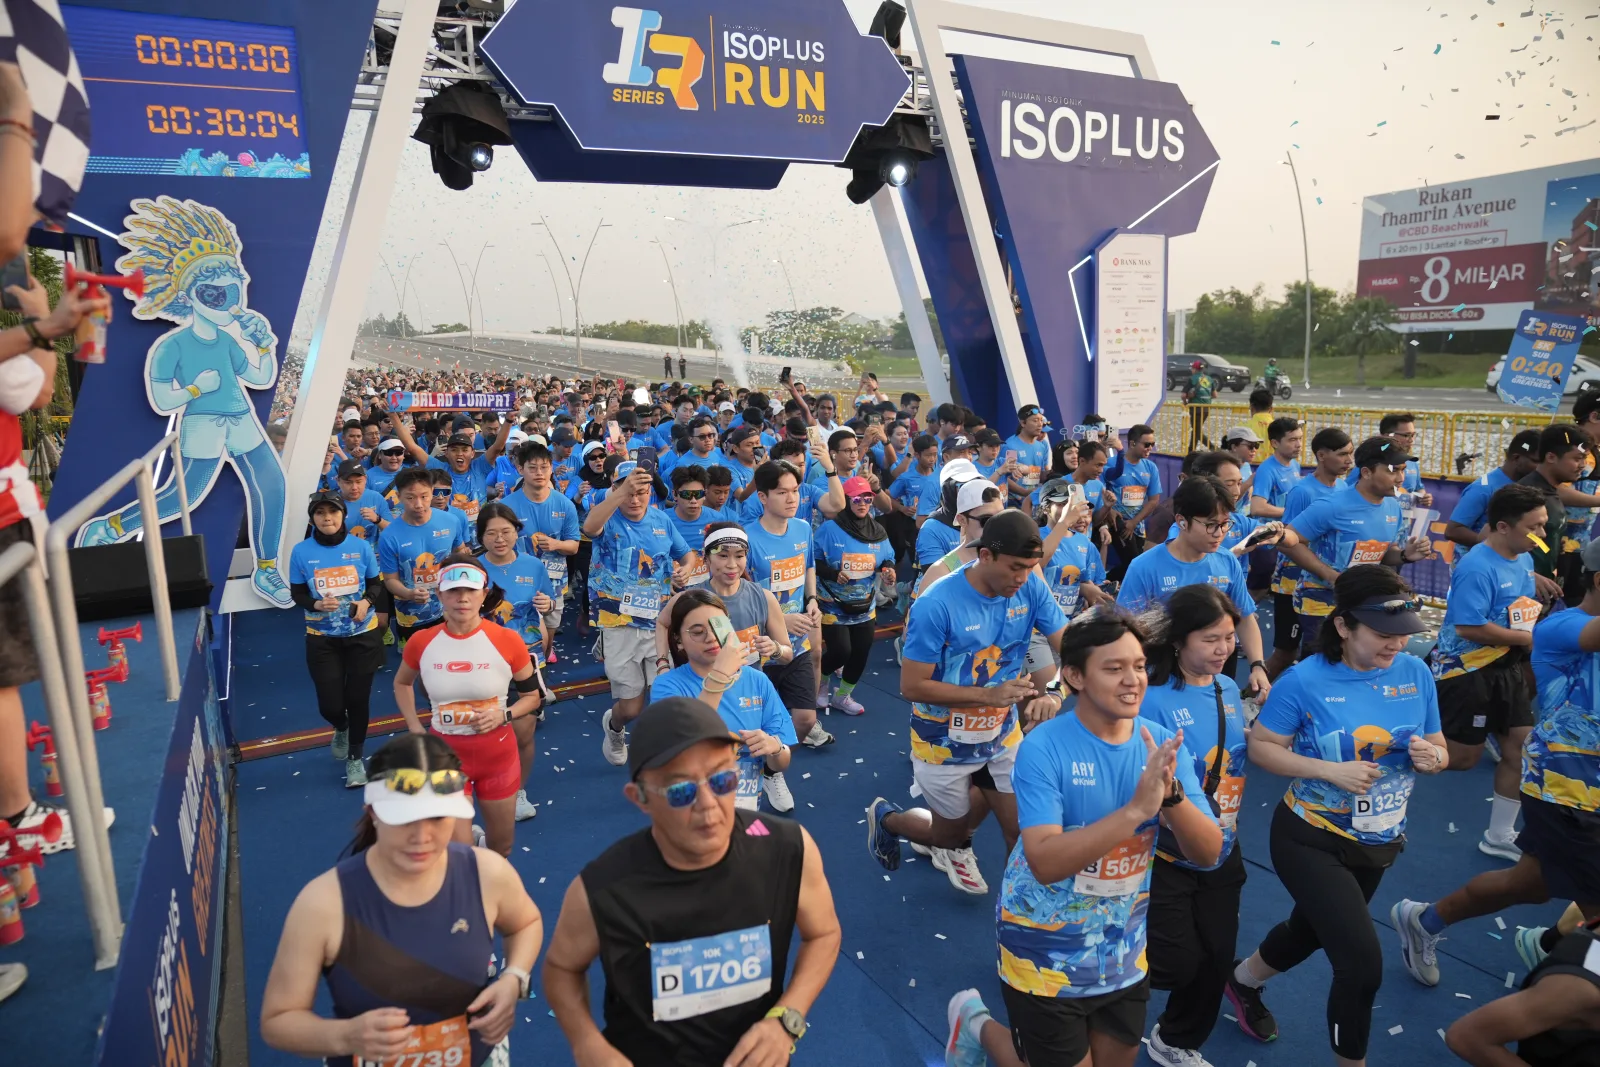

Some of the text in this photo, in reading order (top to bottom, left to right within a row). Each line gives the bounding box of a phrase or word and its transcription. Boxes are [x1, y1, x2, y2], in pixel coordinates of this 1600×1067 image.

[135, 34, 290, 73] 00:00:00
[723, 31, 825, 63] ISOPLUS
[724, 62, 825, 111] RUN
[612, 88, 664, 105] SERIES
[1001, 90, 1083, 107] MINUMAN ISOTONIK
[146, 104, 299, 138] 00:30:04
[797, 113, 825, 125] 2025
[1001, 100, 1185, 163] ISOPLUS
[1419, 187, 1473, 206] Rukan
[1453, 198, 1517, 218] Avenue
[1398, 218, 1490, 238] @CBD Beachwalk
[1421, 256, 1451, 304] 8
[1454, 263, 1526, 285] MILIAR
[1410, 311, 1428, 320] BISA
[1461, 310, 1479, 319] 60x
[1548, 328, 1576, 340] RUN
[1531, 351, 1551, 359] SUB
[1510, 356, 1563, 378] 0:40
[1511, 378, 1553, 390] GREATNESS
[412, 392, 511, 408] BALAD LUMPAT
[1354, 552, 1361, 560] C
[773, 564, 803, 581] B 5513
[843, 562, 850, 570] C
[318, 575, 356, 588] D 5195
[623, 595, 659, 608] B 2281
[1512, 611, 1521, 622] B
[443, 713, 453, 723] D
[953, 717, 963, 727] B
[1172, 707, 1192, 722] LYR
[1072, 761, 1095, 776] ARY
[1358, 800, 1370, 813] D
[1104, 850, 1149, 877] 5674
[703, 947, 721, 959] 10K
[660, 955, 762, 993] D 1706
